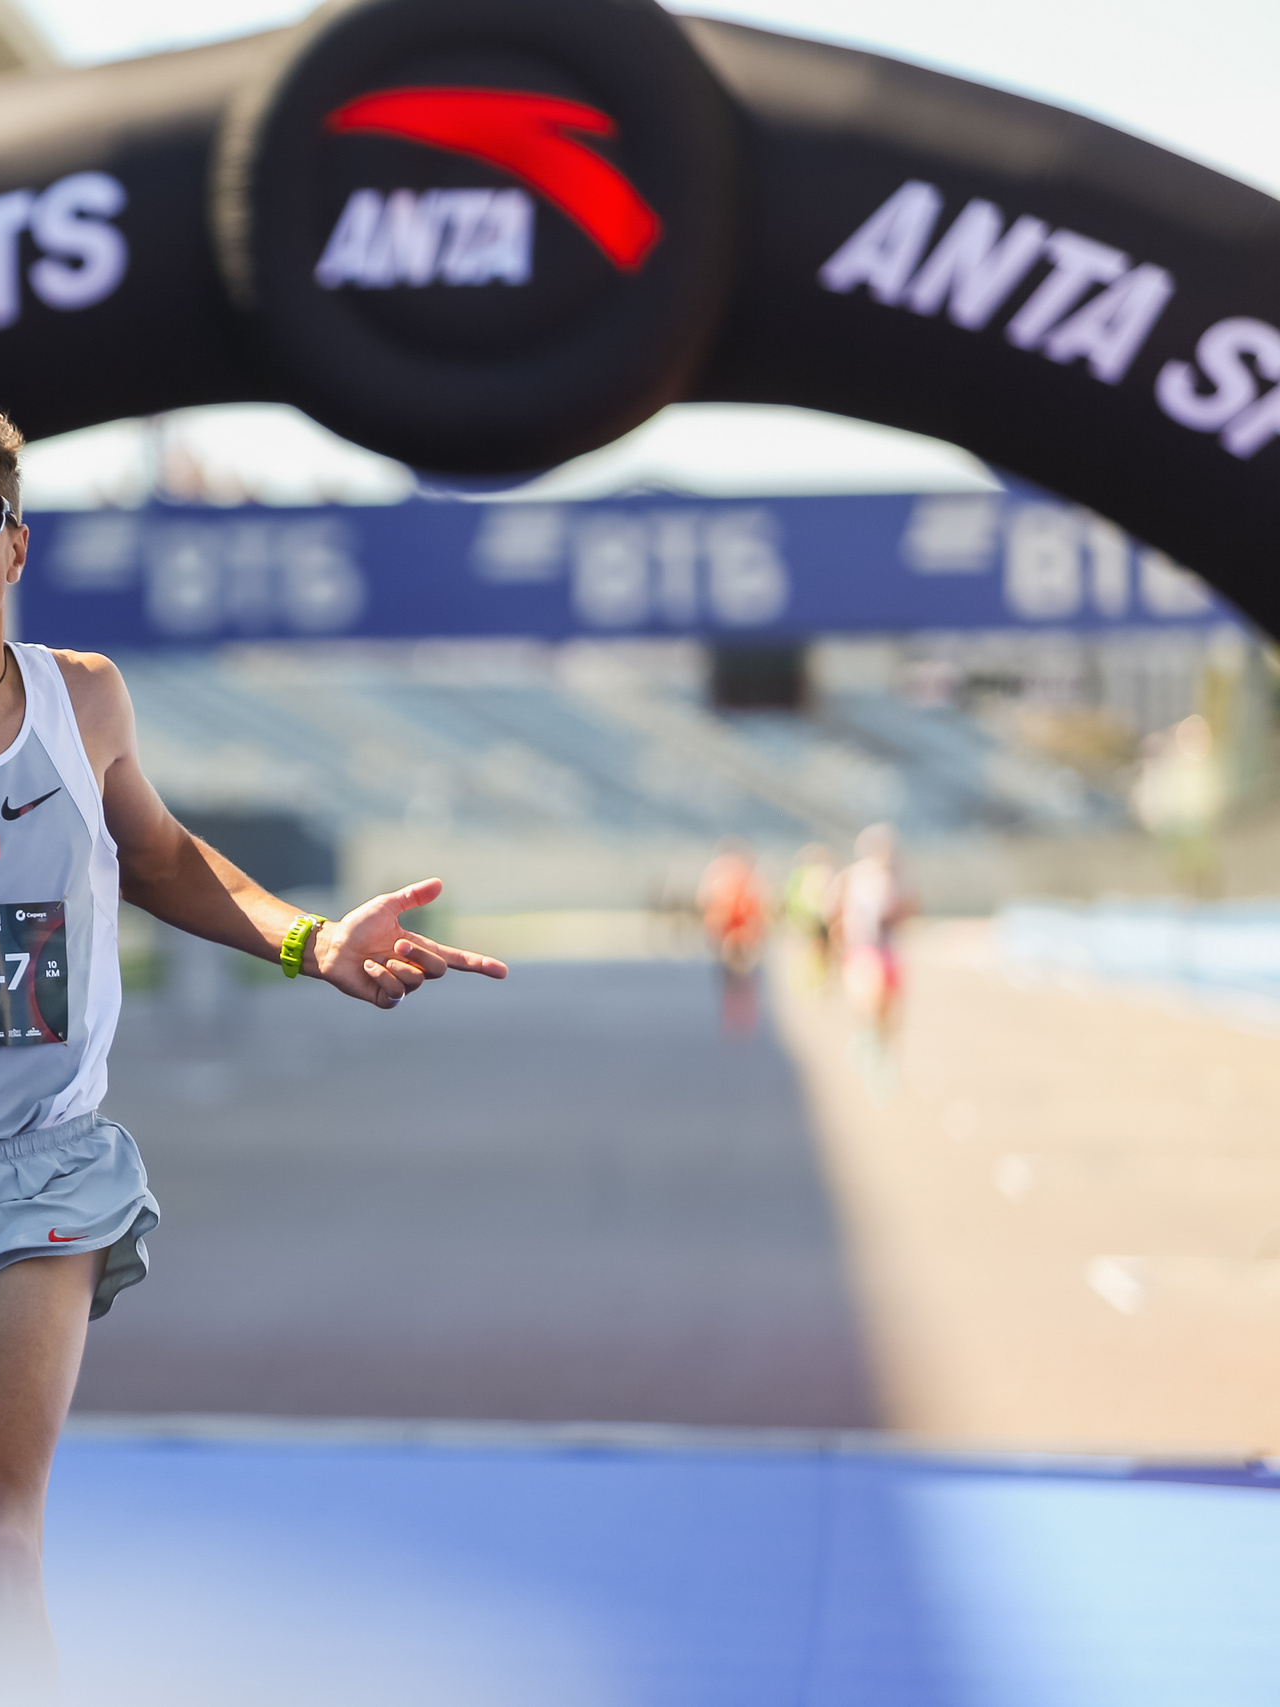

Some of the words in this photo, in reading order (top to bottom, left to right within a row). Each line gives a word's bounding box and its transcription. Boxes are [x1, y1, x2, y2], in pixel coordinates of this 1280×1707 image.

[315, 187, 535, 288] ANTA
[820, 179, 1175, 386] ANTA
[45, 969, 60, 978] KM
[47, 960, 57, 969] 10
